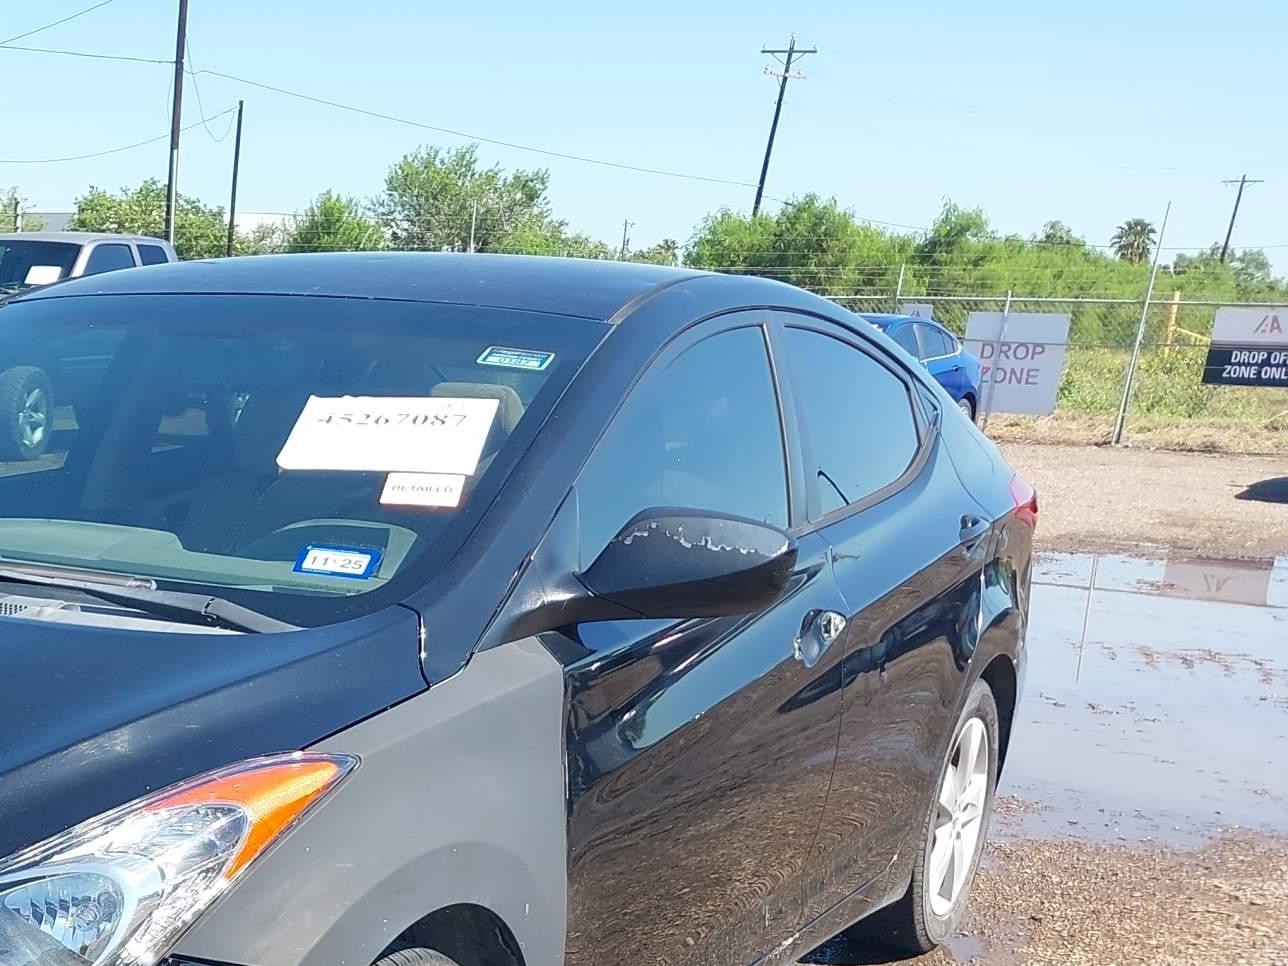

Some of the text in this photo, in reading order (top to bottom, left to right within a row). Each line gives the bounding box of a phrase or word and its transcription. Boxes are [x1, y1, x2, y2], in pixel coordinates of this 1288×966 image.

[980, 343, 1046, 360] DROP
[1231, 351, 1268, 364] DROP
[980, 366, 1040, 385] ZONE
[1222, 365, 1258, 378] ZONE
[317, 412, 468, 427] 45267087
